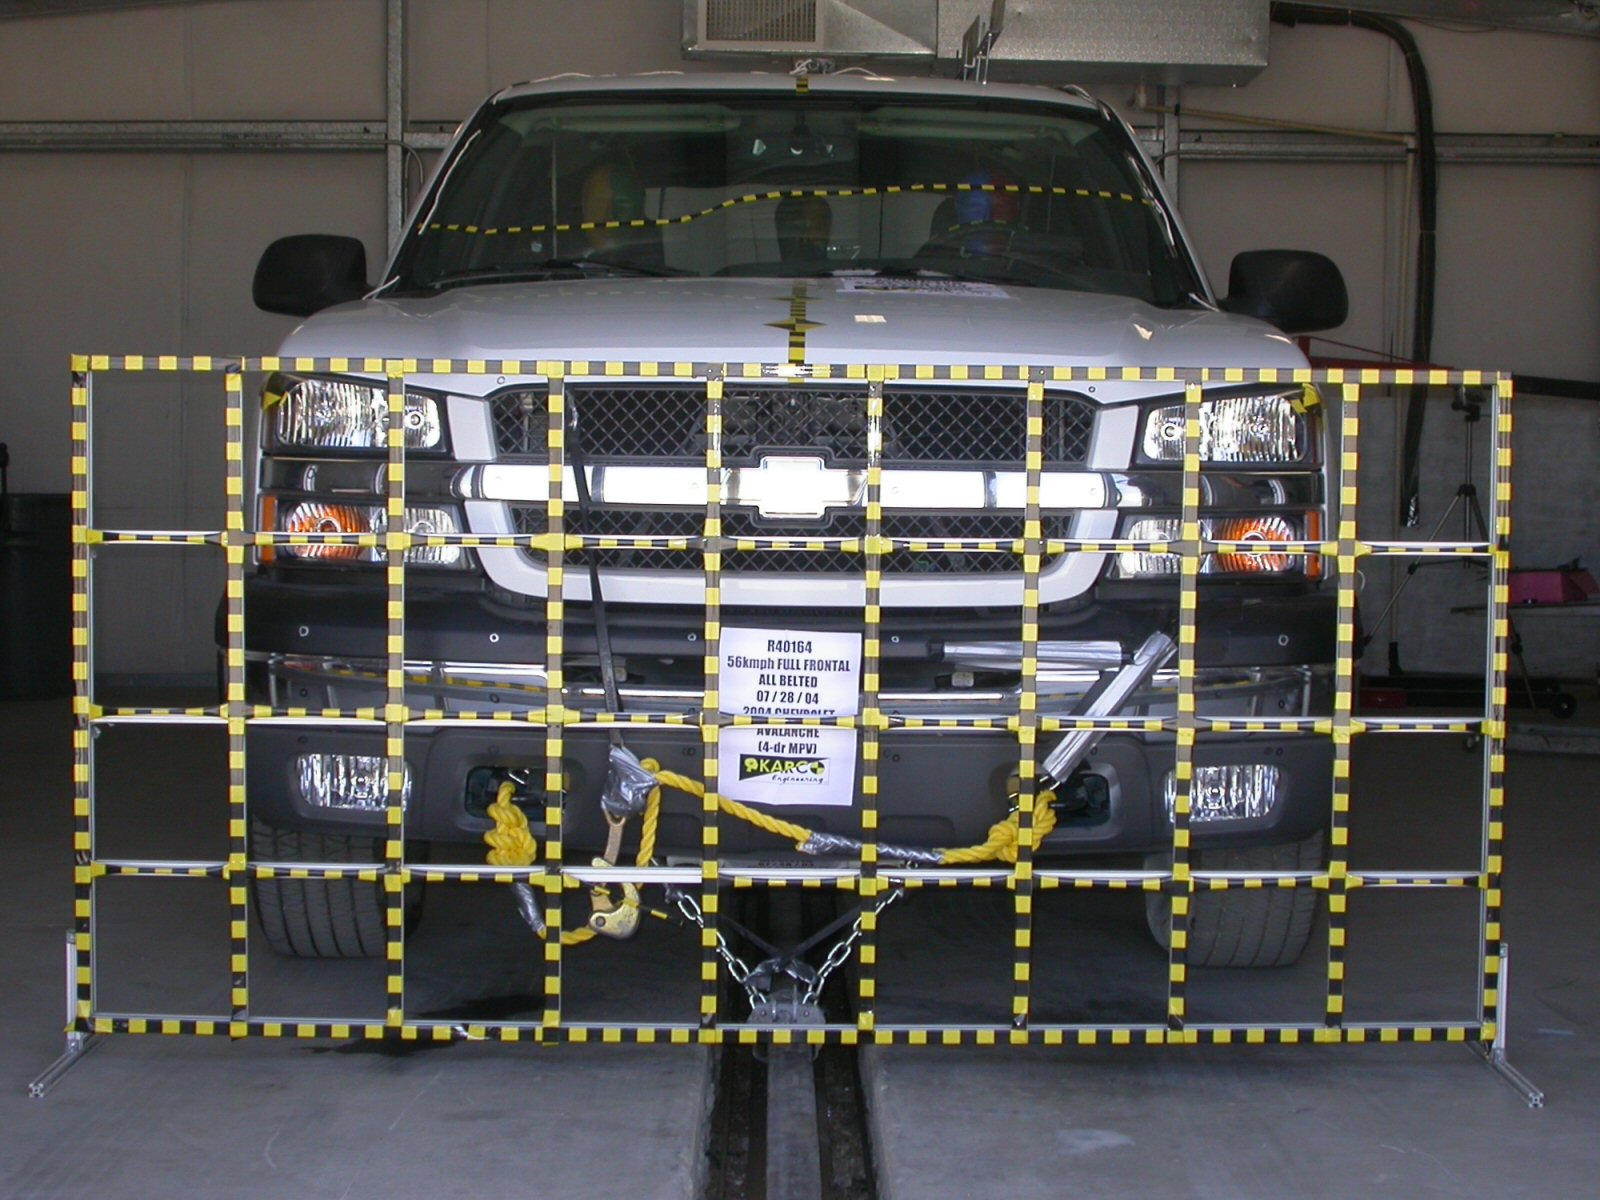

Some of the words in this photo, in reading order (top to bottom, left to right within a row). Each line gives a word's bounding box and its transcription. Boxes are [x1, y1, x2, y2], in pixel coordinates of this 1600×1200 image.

[768, 640, 812, 653] R40164
[727, 655, 774, 670] 56kmph
[777, 658, 800, 670] FULL
[804, 659, 851, 672] FRONTAL
[759, 674, 776, 686] ALL
[780, 675, 817, 687] BELTED
[758, 741, 786, 754] (4-dr
[789, 743, 817, 755] MPV)
